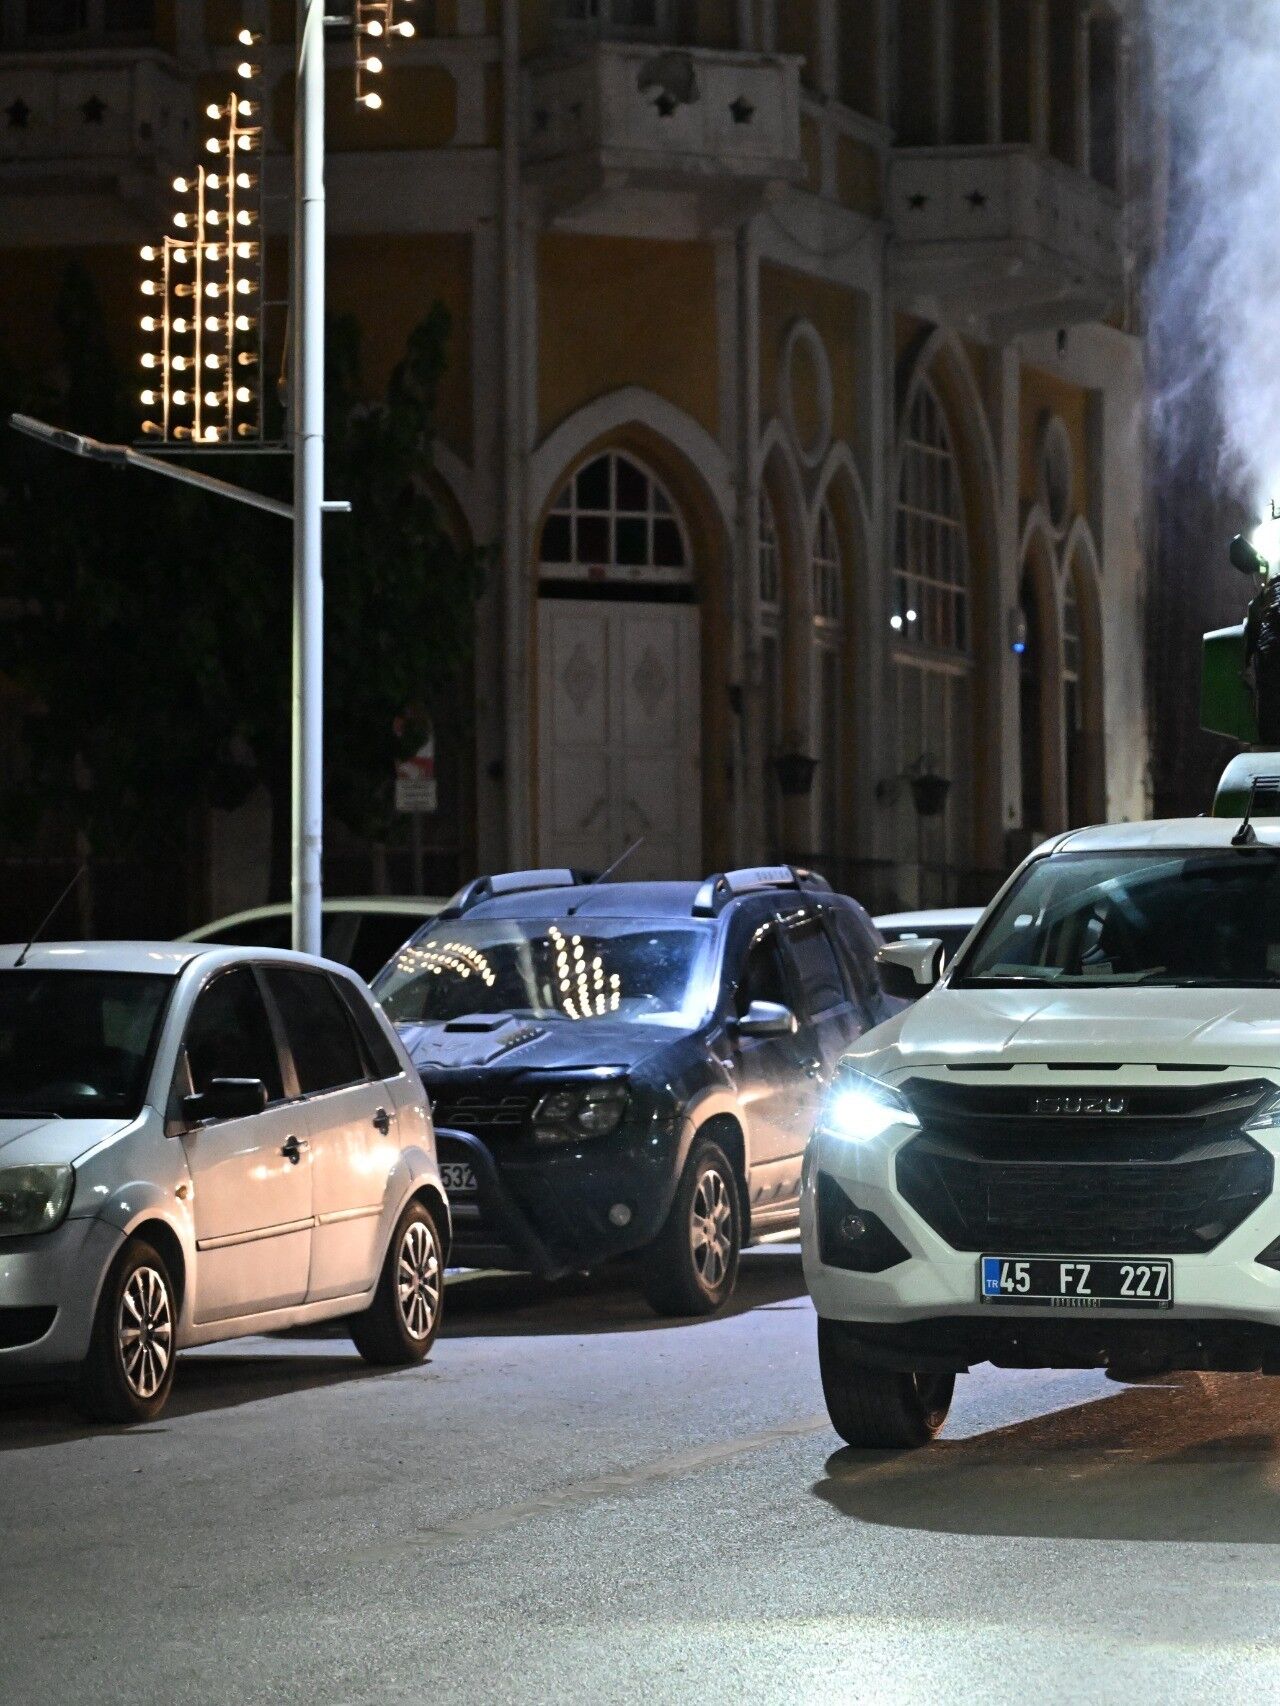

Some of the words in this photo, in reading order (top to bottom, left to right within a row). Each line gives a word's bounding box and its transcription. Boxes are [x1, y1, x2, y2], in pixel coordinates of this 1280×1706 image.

[1034, 1096, 1124, 1113] ISUZU
[986, 1279, 999, 1288] TR
[1000, 1262, 1031, 1293] 45
[1059, 1263, 1092, 1294] FZ
[1119, 1265, 1167, 1297] 227
